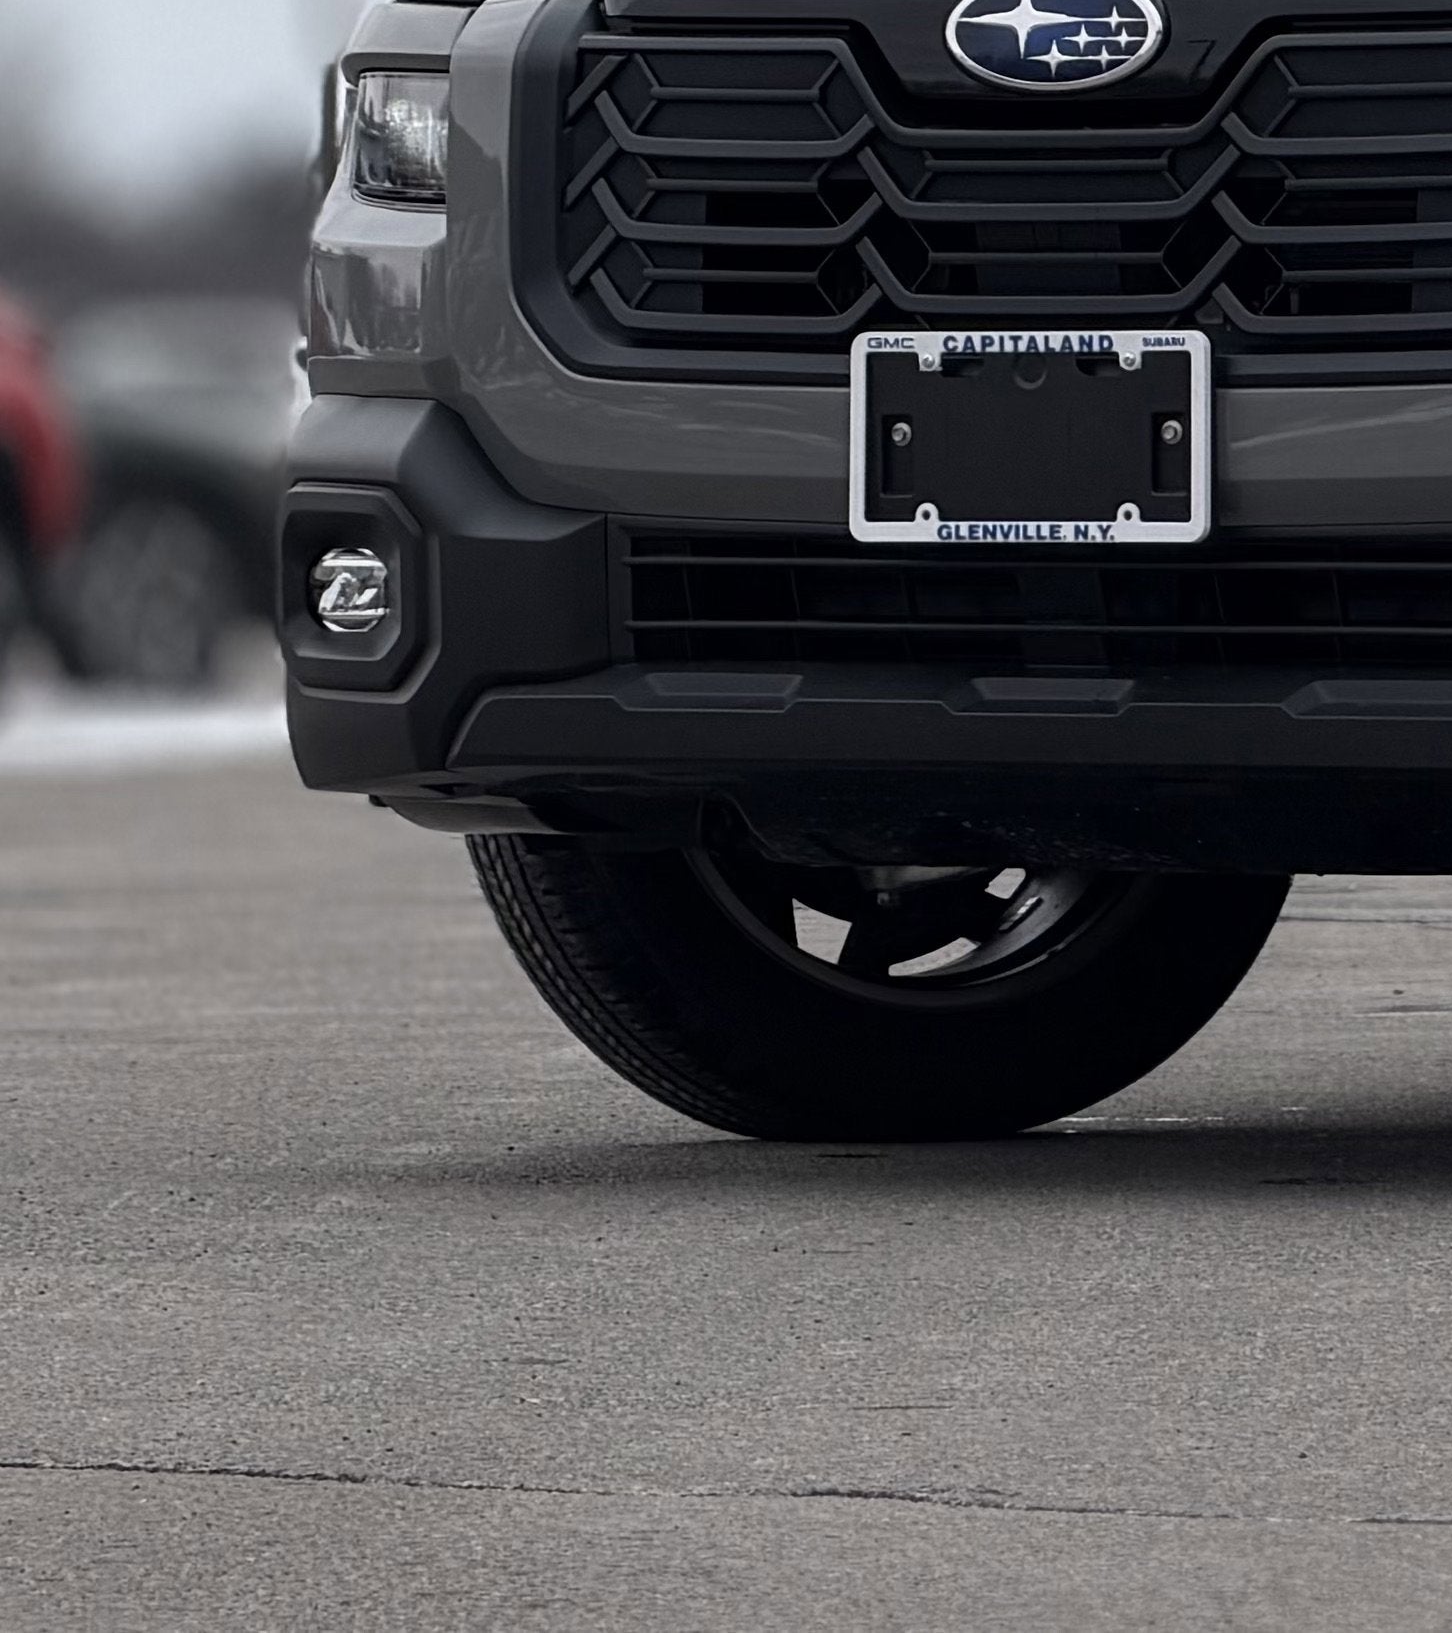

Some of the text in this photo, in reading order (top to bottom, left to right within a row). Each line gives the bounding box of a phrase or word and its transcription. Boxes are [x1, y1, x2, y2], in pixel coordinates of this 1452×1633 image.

[867, 337, 915, 350] GMC
[943, 335, 1114, 353] CAPITALAND
[1142, 336, 1186, 347] SUBARU
[1074, 525, 1116, 541] N.Y.
